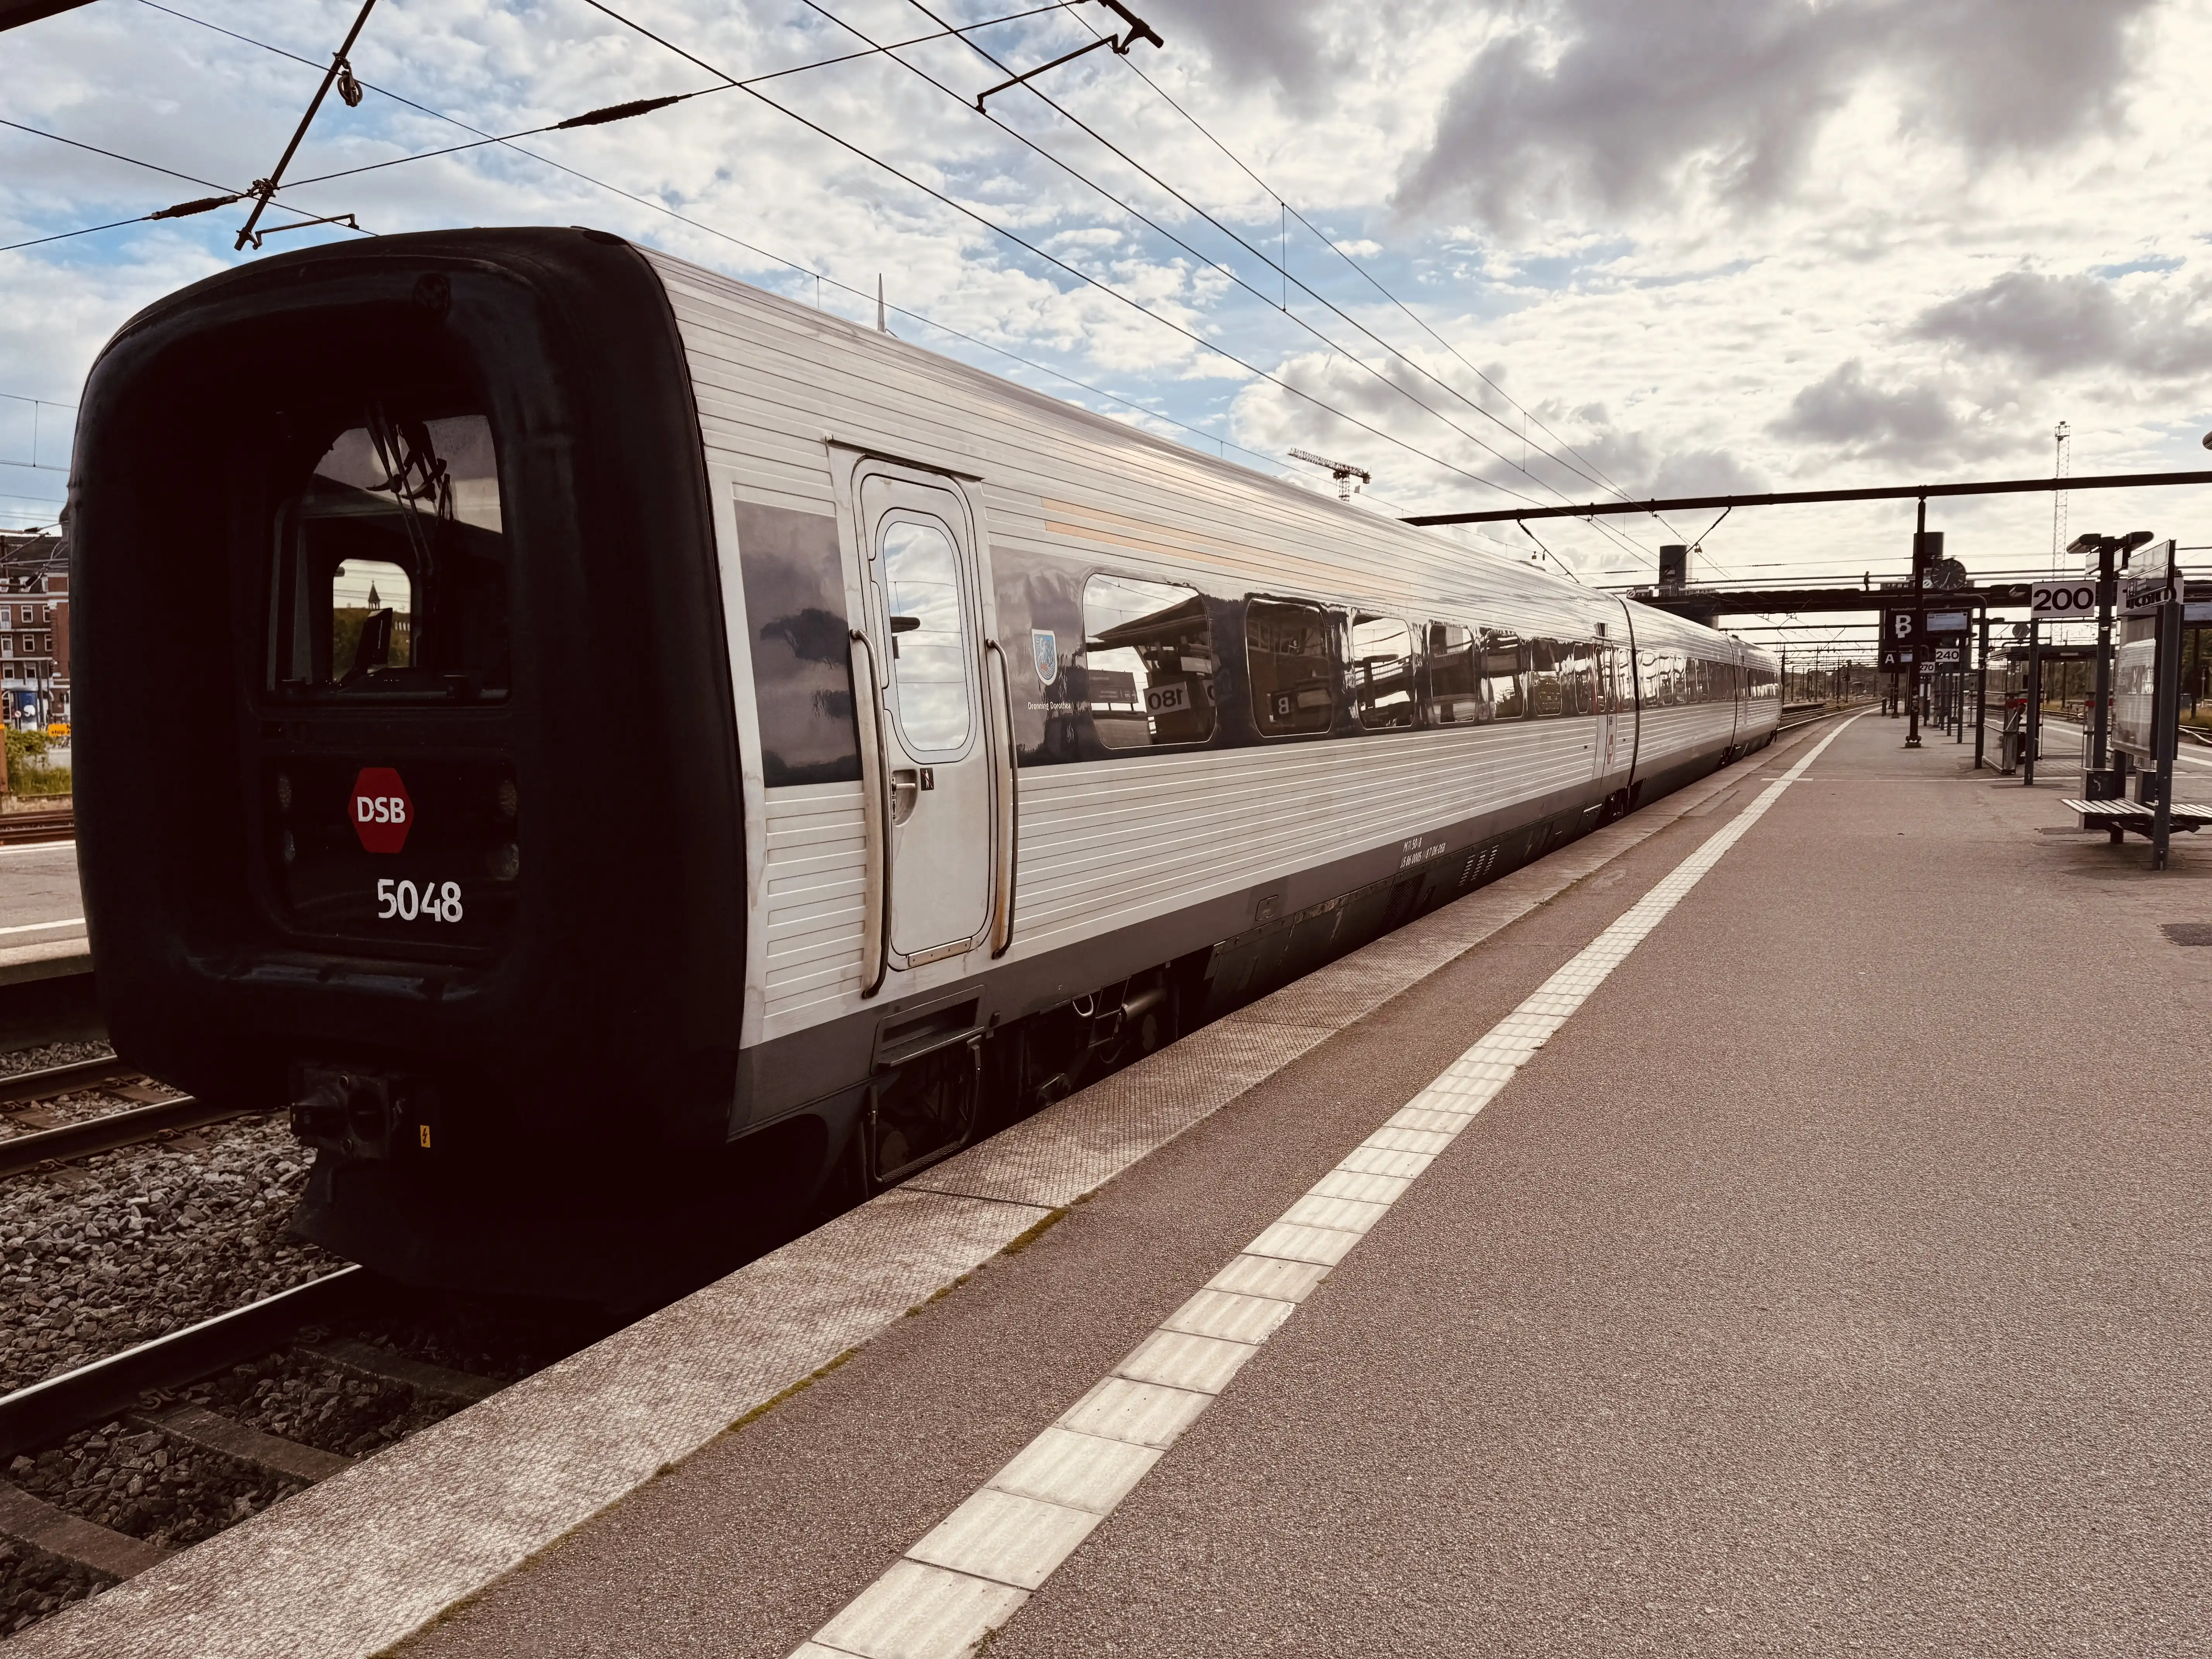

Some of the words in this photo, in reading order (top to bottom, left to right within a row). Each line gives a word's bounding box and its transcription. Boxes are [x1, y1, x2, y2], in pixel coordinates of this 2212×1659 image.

[2033, 587, 2094, 611] 200
[1896, 615, 1911, 634] B
[1885, 654, 1894, 663] A
[1936, 651, 1959, 659] 240
[1028, 702, 1049, 710] Dronning
[1050, 701, 1071, 709] Dorothea
[357, 797, 405, 823] DSB
[378, 879, 463, 922] 5048
